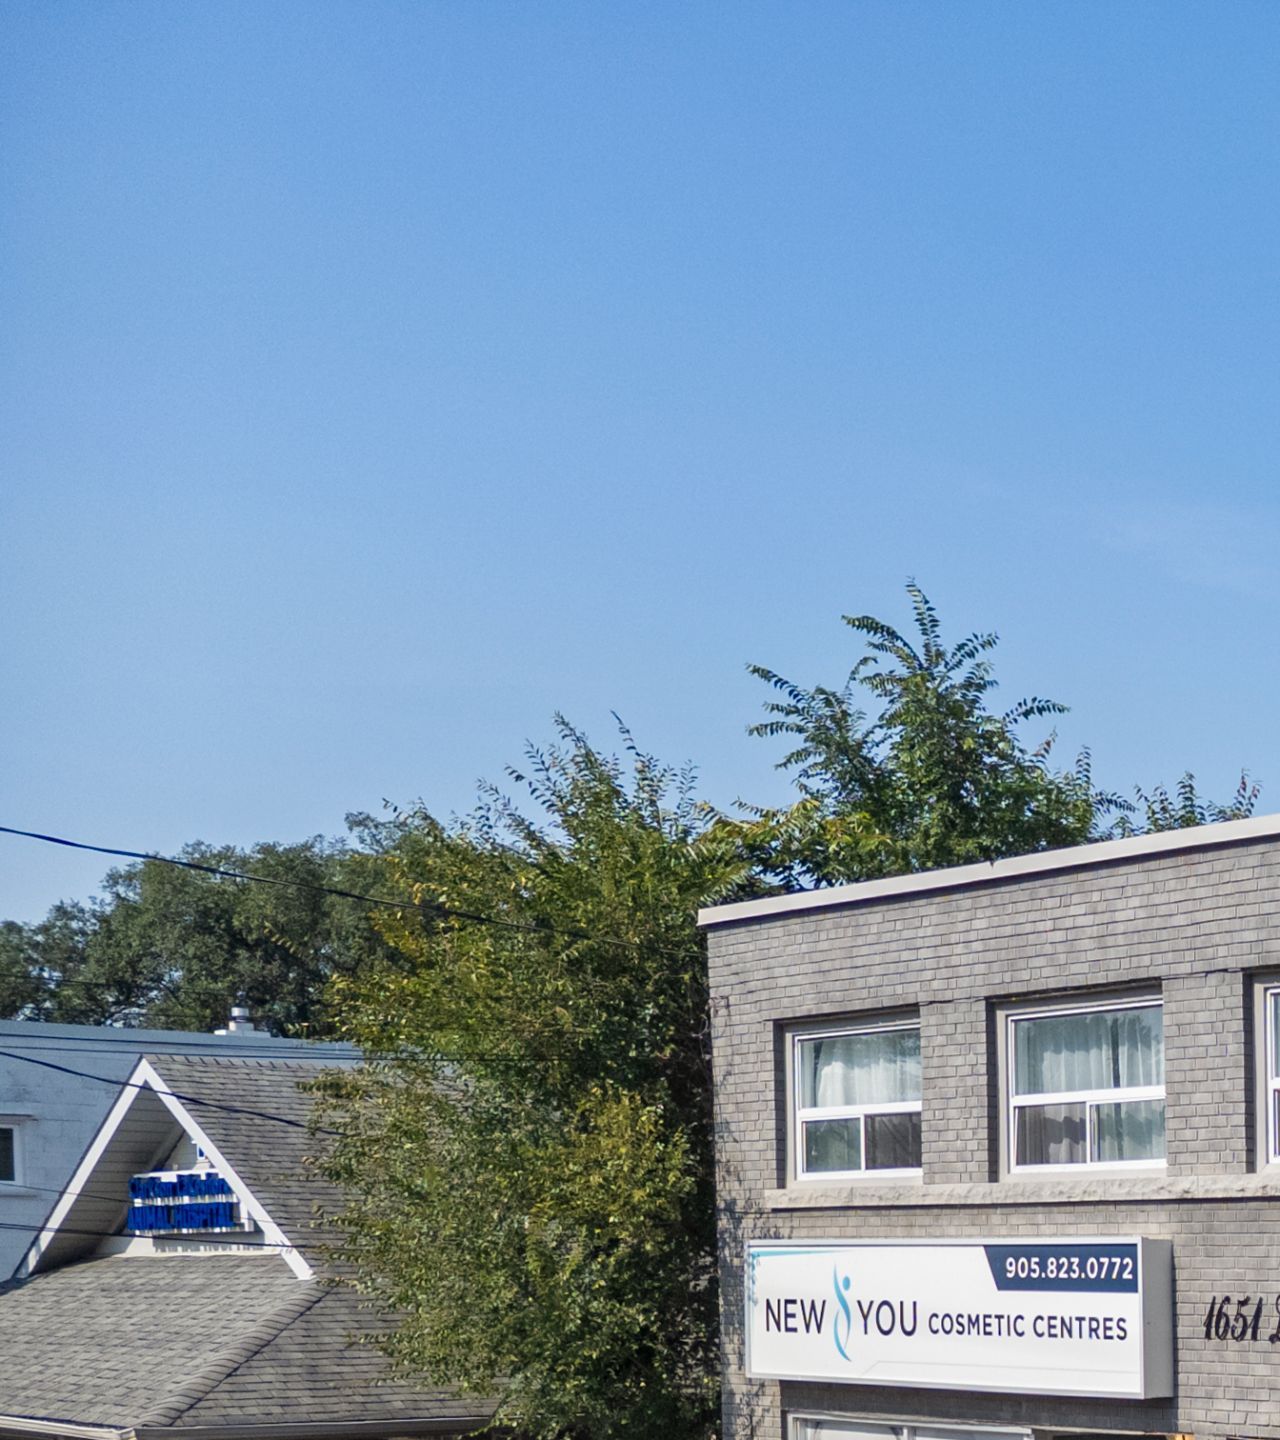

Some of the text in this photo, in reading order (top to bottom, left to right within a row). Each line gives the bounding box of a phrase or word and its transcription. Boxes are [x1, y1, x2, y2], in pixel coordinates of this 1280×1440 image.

[1006, 1257, 1133, 1280] 905.823.0772
[765, 1298, 1127, 1340] NEW YOU COSMETIC CENTRES
[1204, 1296, 1263, 1341] 1651
